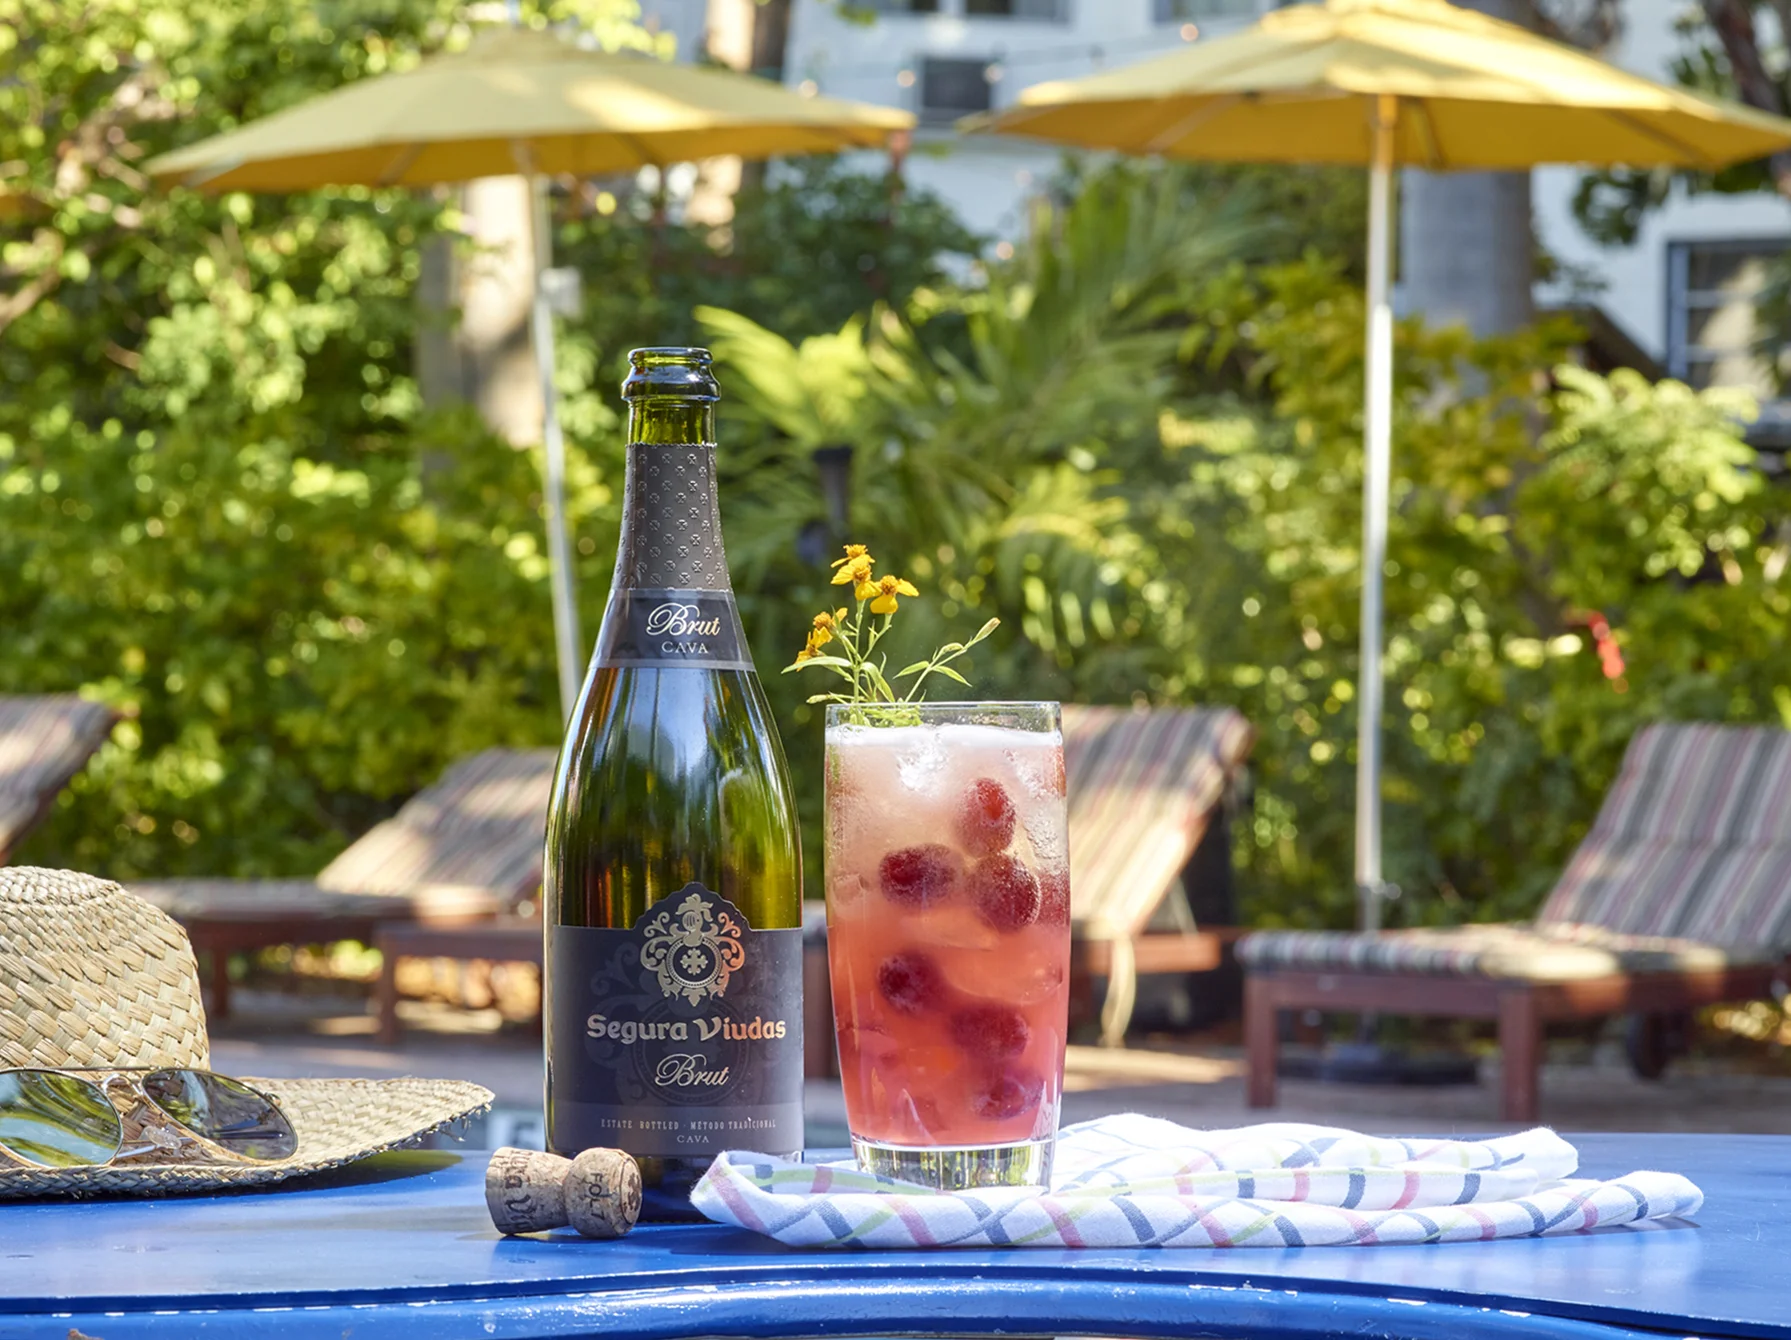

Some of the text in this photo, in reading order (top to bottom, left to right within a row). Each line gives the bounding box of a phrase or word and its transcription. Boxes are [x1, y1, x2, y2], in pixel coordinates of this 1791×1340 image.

[646, 602, 720, 636] Brut
[661, 641, 709, 654] CAVA
[587, 1014, 786, 1045] Segura Viudas
[655, 1053, 729, 1086] Brut
[601, 1118, 632, 1129] ESTATE
[639, 1120, 679, 1130] BOTTLED
[728, 1119, 776, 1130] TRADICIONAL
[676, 1134, 709, 1143] CAVA
